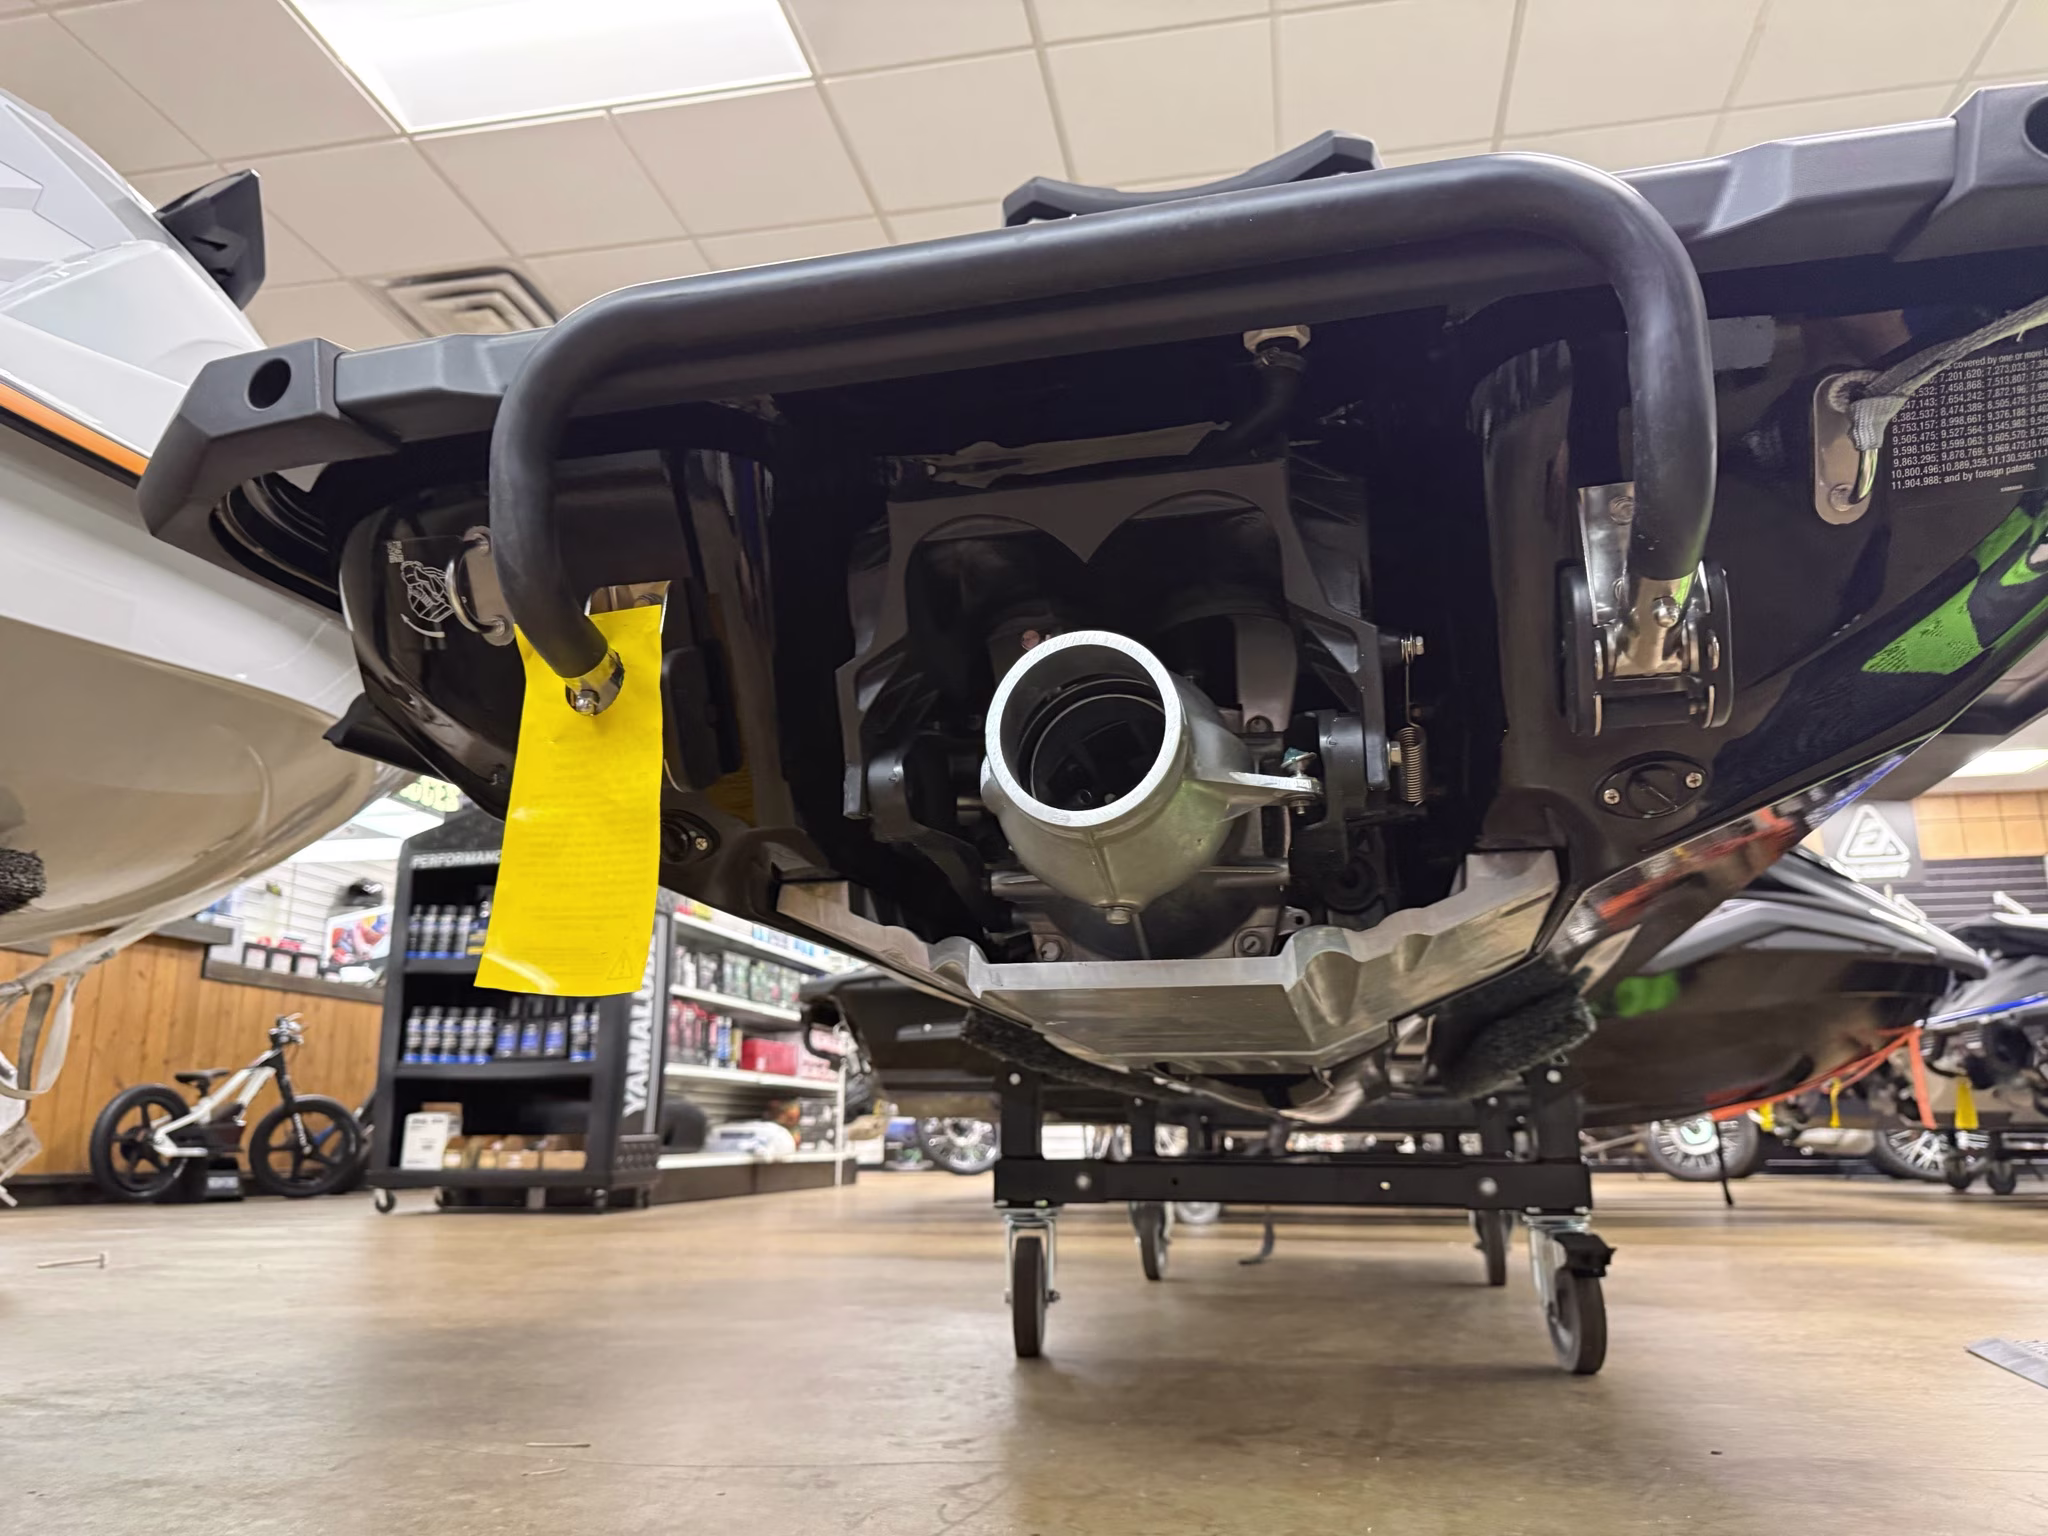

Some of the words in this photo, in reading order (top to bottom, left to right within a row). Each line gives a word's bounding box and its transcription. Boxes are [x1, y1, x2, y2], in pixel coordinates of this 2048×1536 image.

[1953, 356, 1986, 369] covered
[1987, 355, 1998, 366] by
[1943, 472, 1961, 483] and
[1962, 470, 1973, 482] by
[1975, 466, 2004, 478] foreign
